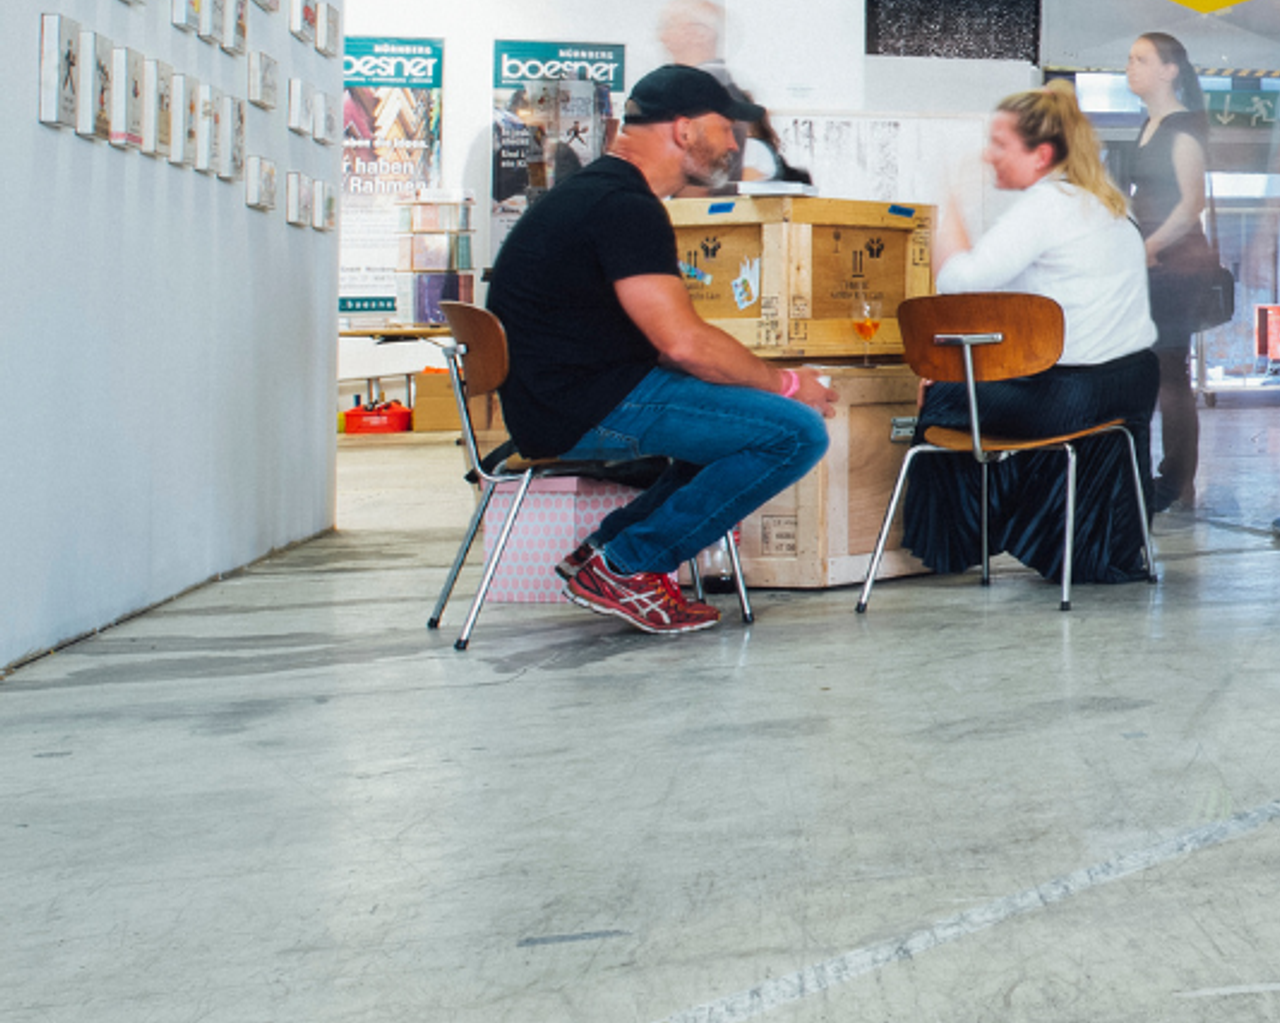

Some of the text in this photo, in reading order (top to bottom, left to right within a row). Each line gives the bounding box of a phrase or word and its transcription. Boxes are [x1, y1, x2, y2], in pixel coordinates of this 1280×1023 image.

[343, 55, 438, 77] oesner
[501, 53, 619, 82] boesner
[355, 156, 414, 174] haben
